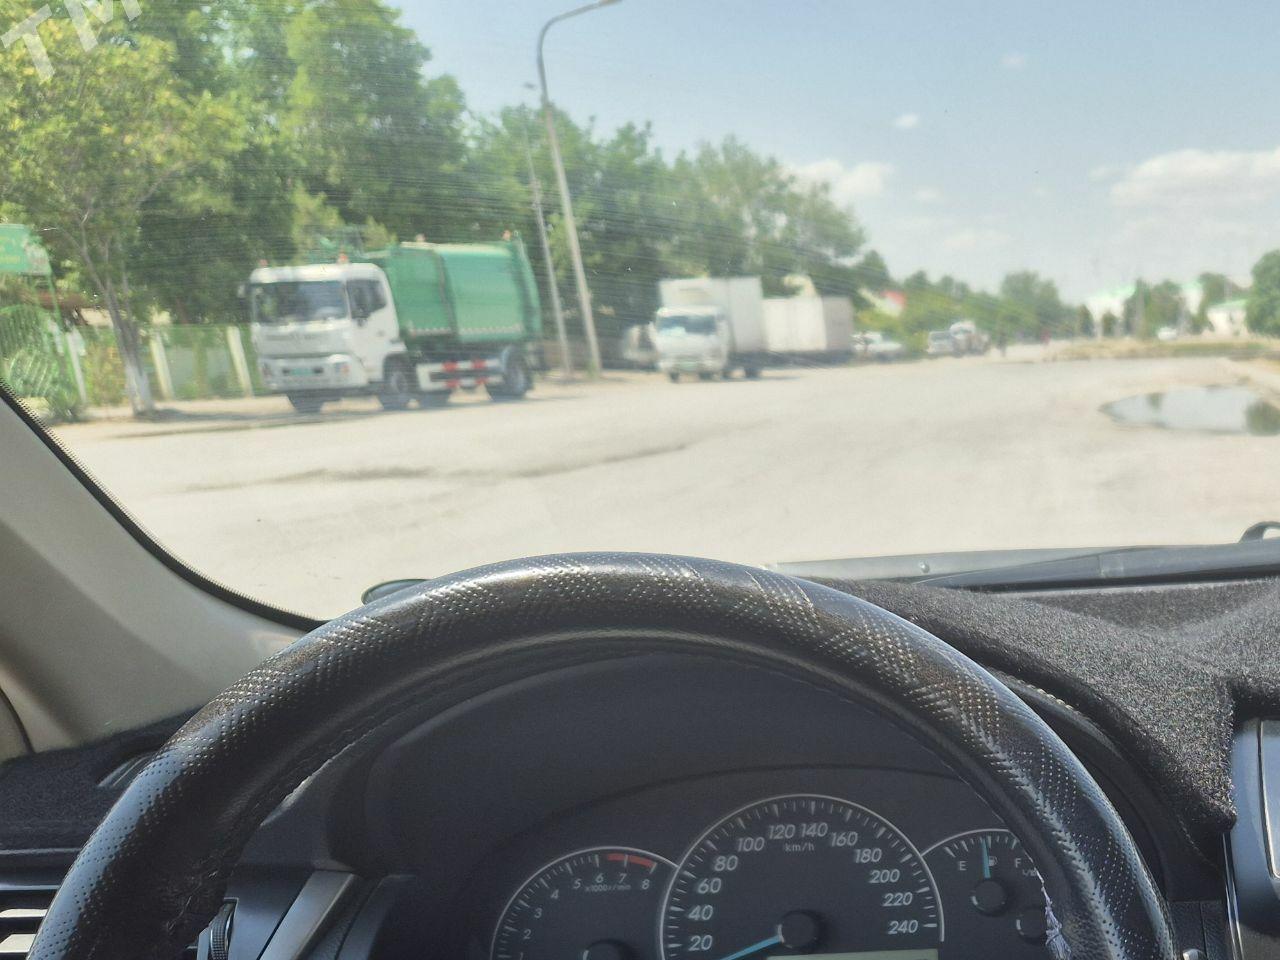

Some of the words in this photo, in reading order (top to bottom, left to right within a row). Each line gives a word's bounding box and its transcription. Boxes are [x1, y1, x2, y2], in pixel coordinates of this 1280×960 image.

[768, 824, 796, 839] 120
[801, 822, 828, 838] 140
[738, 836, 765, 851] 100
[785, 841, 815, 852] km/h
[831, 831, 858, 847] 160
[713, 855, 739, 872] 80
[855, 848, 882, 864] 180
[1015, 857, 1022, 868] F
[959, 860, 967, 871] E
[573, 879, 582, 889] 5
[596, 873, 604, 884] 6
[618, 873, 627, 884] 7
[869, 869, 900, 884] 200
[641, 879, 650, 890] 8
[697, 878, 722, 894] 60
[551, 889, 559, 900] 4
[882, 892, 913, 907] 220
[534, 908, 542, 918] 3
[688, 905, 713, 921] 40
[523, 929, 531, 940] 2
[888, 920, 919, 935] 240
[689, 934, 713, 951] 20
